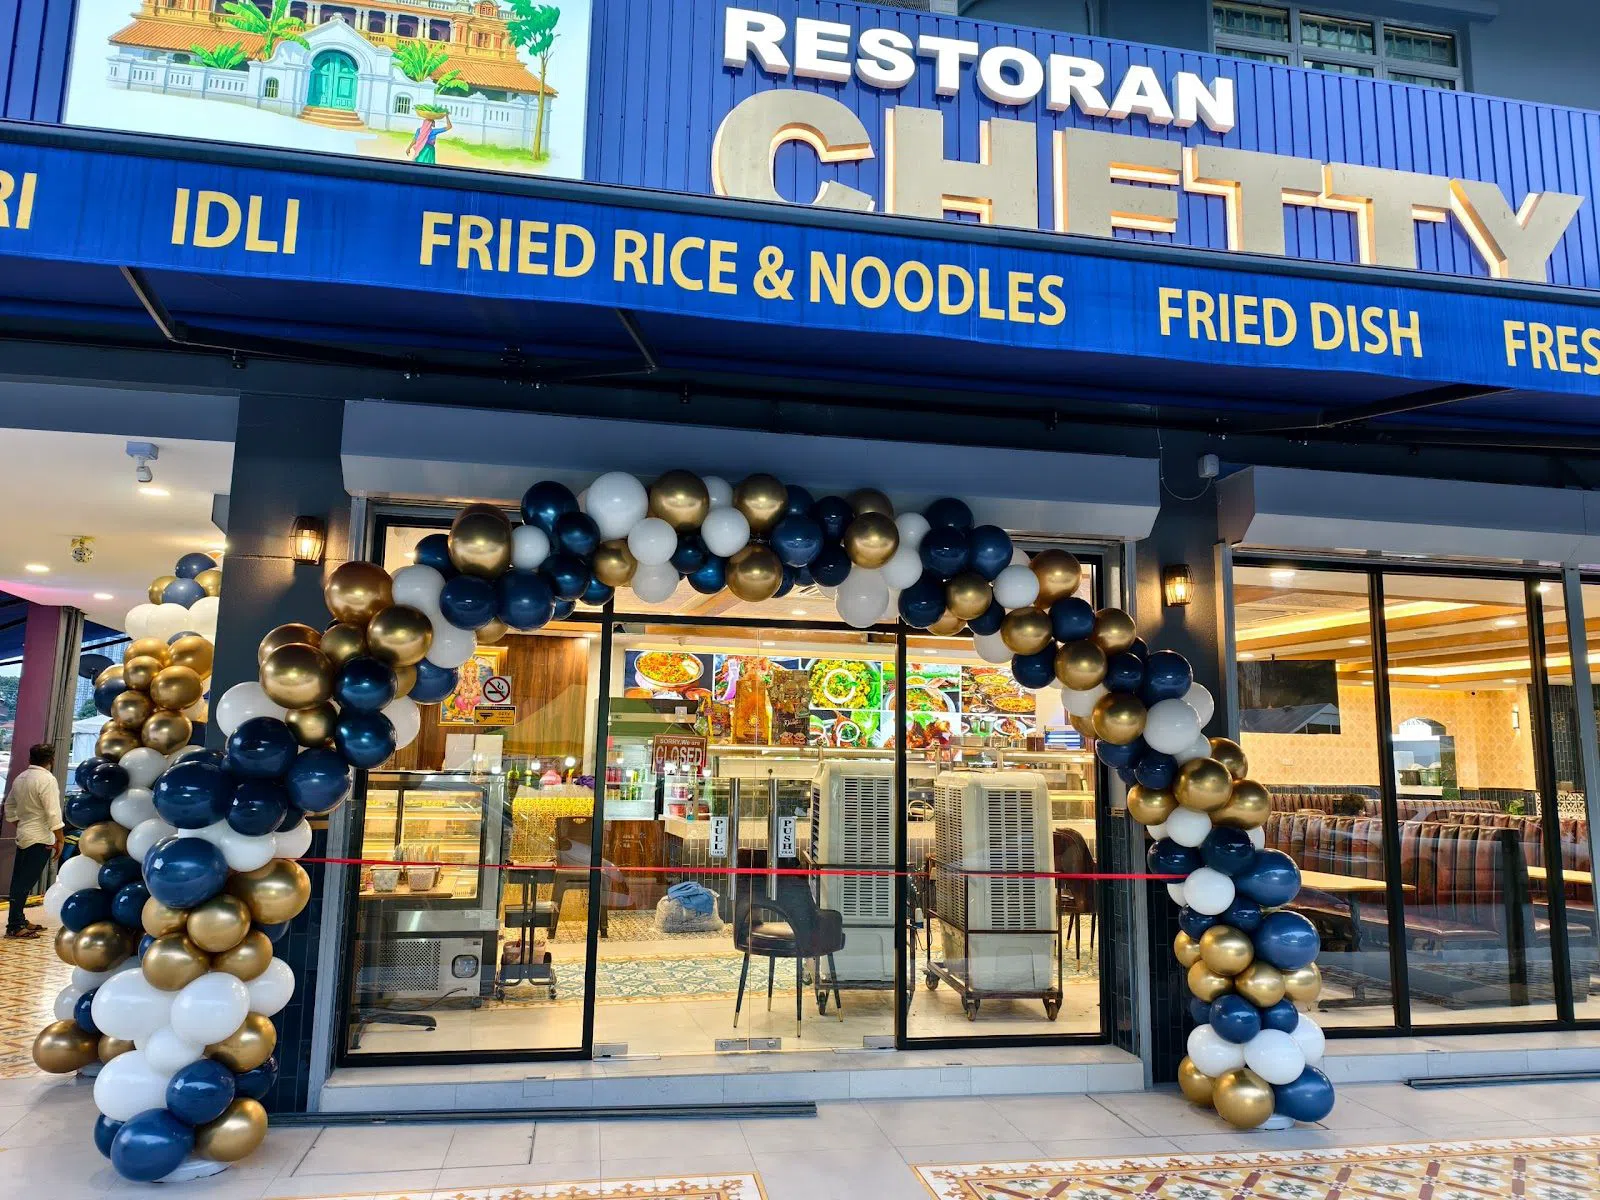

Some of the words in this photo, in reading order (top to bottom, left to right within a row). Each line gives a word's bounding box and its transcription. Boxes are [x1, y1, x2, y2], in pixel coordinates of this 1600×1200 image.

[723, 7, 1235, 133] RESTORAN
[712, 89, 1585, 282] CHETTY
[172, 188, 299, 254] IDLI
[420, 211, 596, 279] FRIED
[614, 229, 739, 297] RICE
[753, 245, 794, 302] &
[809, 251, 1067, 327] NOODLES
[1158, 286, 1298, 348] FRIED
[1310, 301, 1423, 359] DISH
[1503, 320, 1600, 376] FRES
[655, 745, 703, 768] CLOSED
[714, 820, 724, 850] PULL
[783, 820, 792, 850] PUSH
